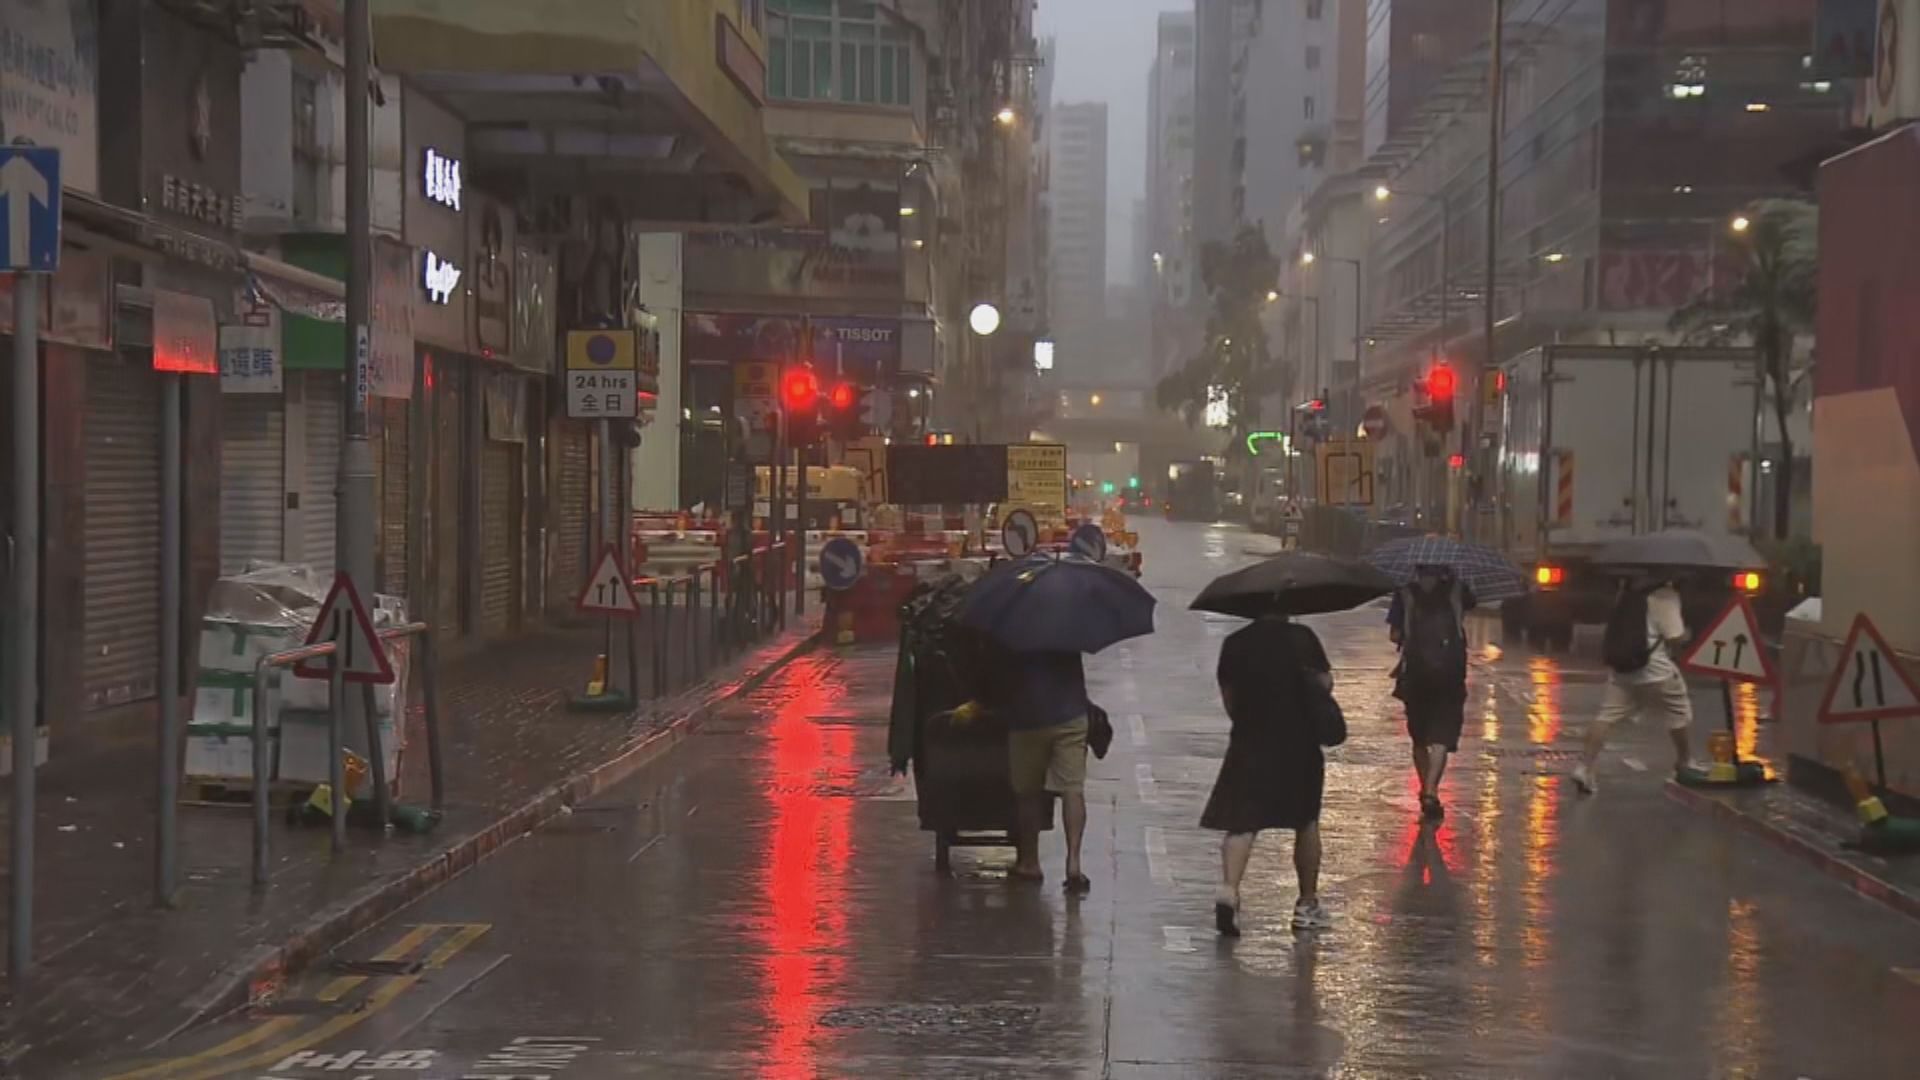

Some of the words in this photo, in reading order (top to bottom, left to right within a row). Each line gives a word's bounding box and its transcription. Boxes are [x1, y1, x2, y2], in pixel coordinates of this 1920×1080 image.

[837, 328, 892, 342] TISSOT
[575, 376, 597, 389] 24
[601, 376, 628, 389] hrs
[580, 394, 621, 412] 全日
